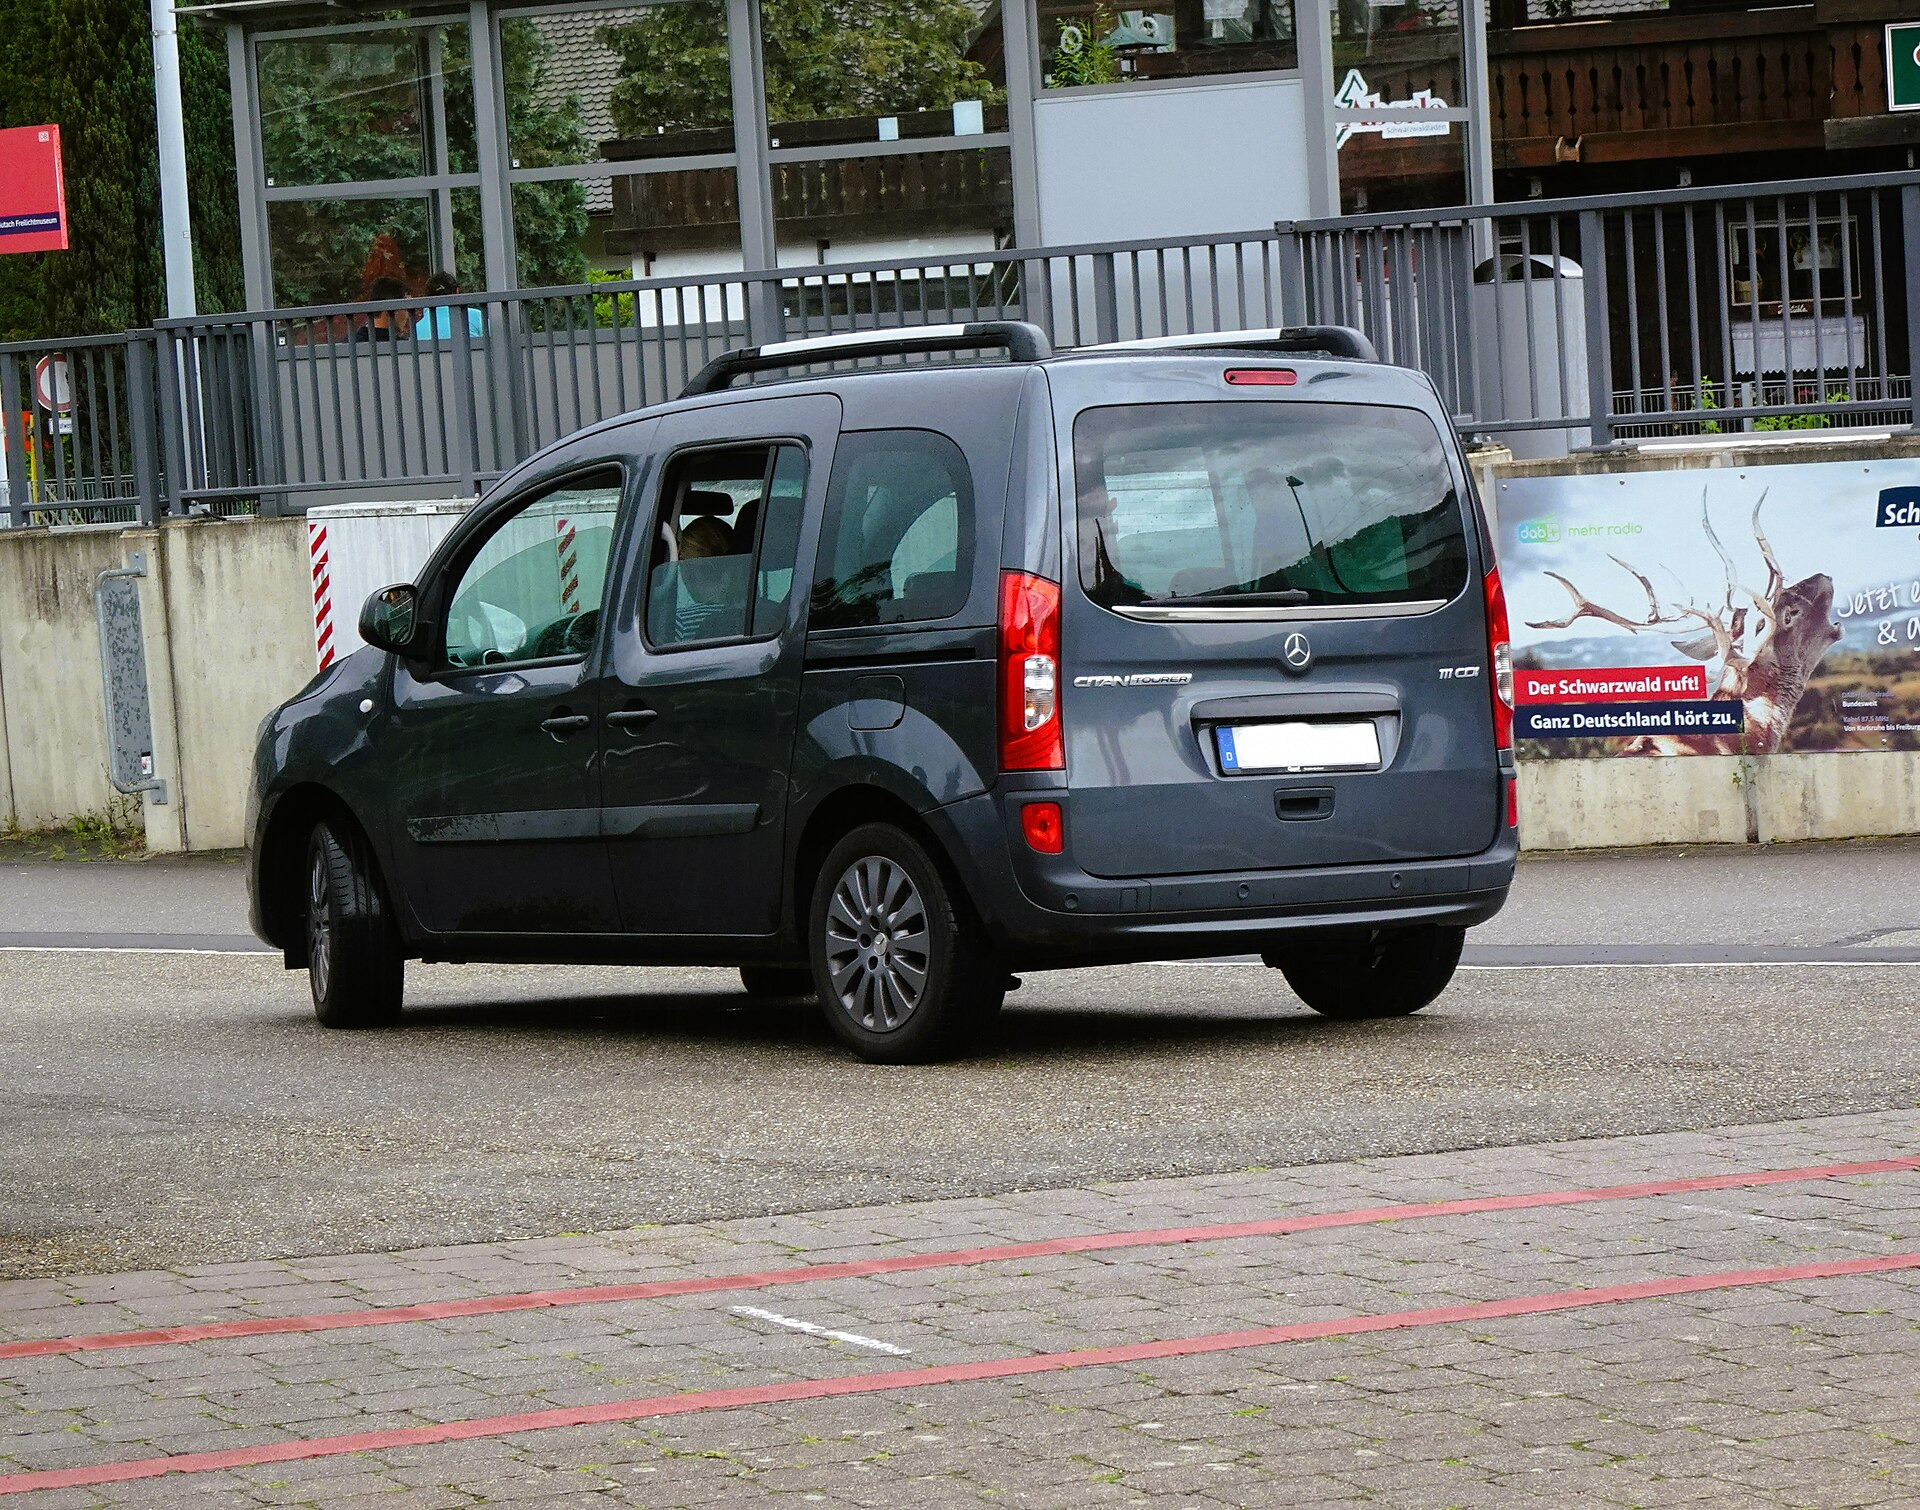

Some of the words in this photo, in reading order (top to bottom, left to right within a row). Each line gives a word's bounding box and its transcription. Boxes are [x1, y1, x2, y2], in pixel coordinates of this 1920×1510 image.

[1568, 524, 1603, 537] mehr
[1607, 522, 1643, 535] radio
[1837, 581, 1901, 618] Jetzt
[1073, 675, 1130, 688] CITAN
[1134, 676, 1188, 684] TOURER
[1528, 680, 1556, 696] Der
[1558, 677, 1661, 695] Schwarzwald
[1664, 675, 1699, 692] ruft!
[1530, 713, 1571, 730] Ganz
[1573, 711, 1671, 728] Deutschland
[1674, 709, 1709, 727] hört
[1711, 712, 1737, 726] zu.
[1226, 752, 1233, 762] D
